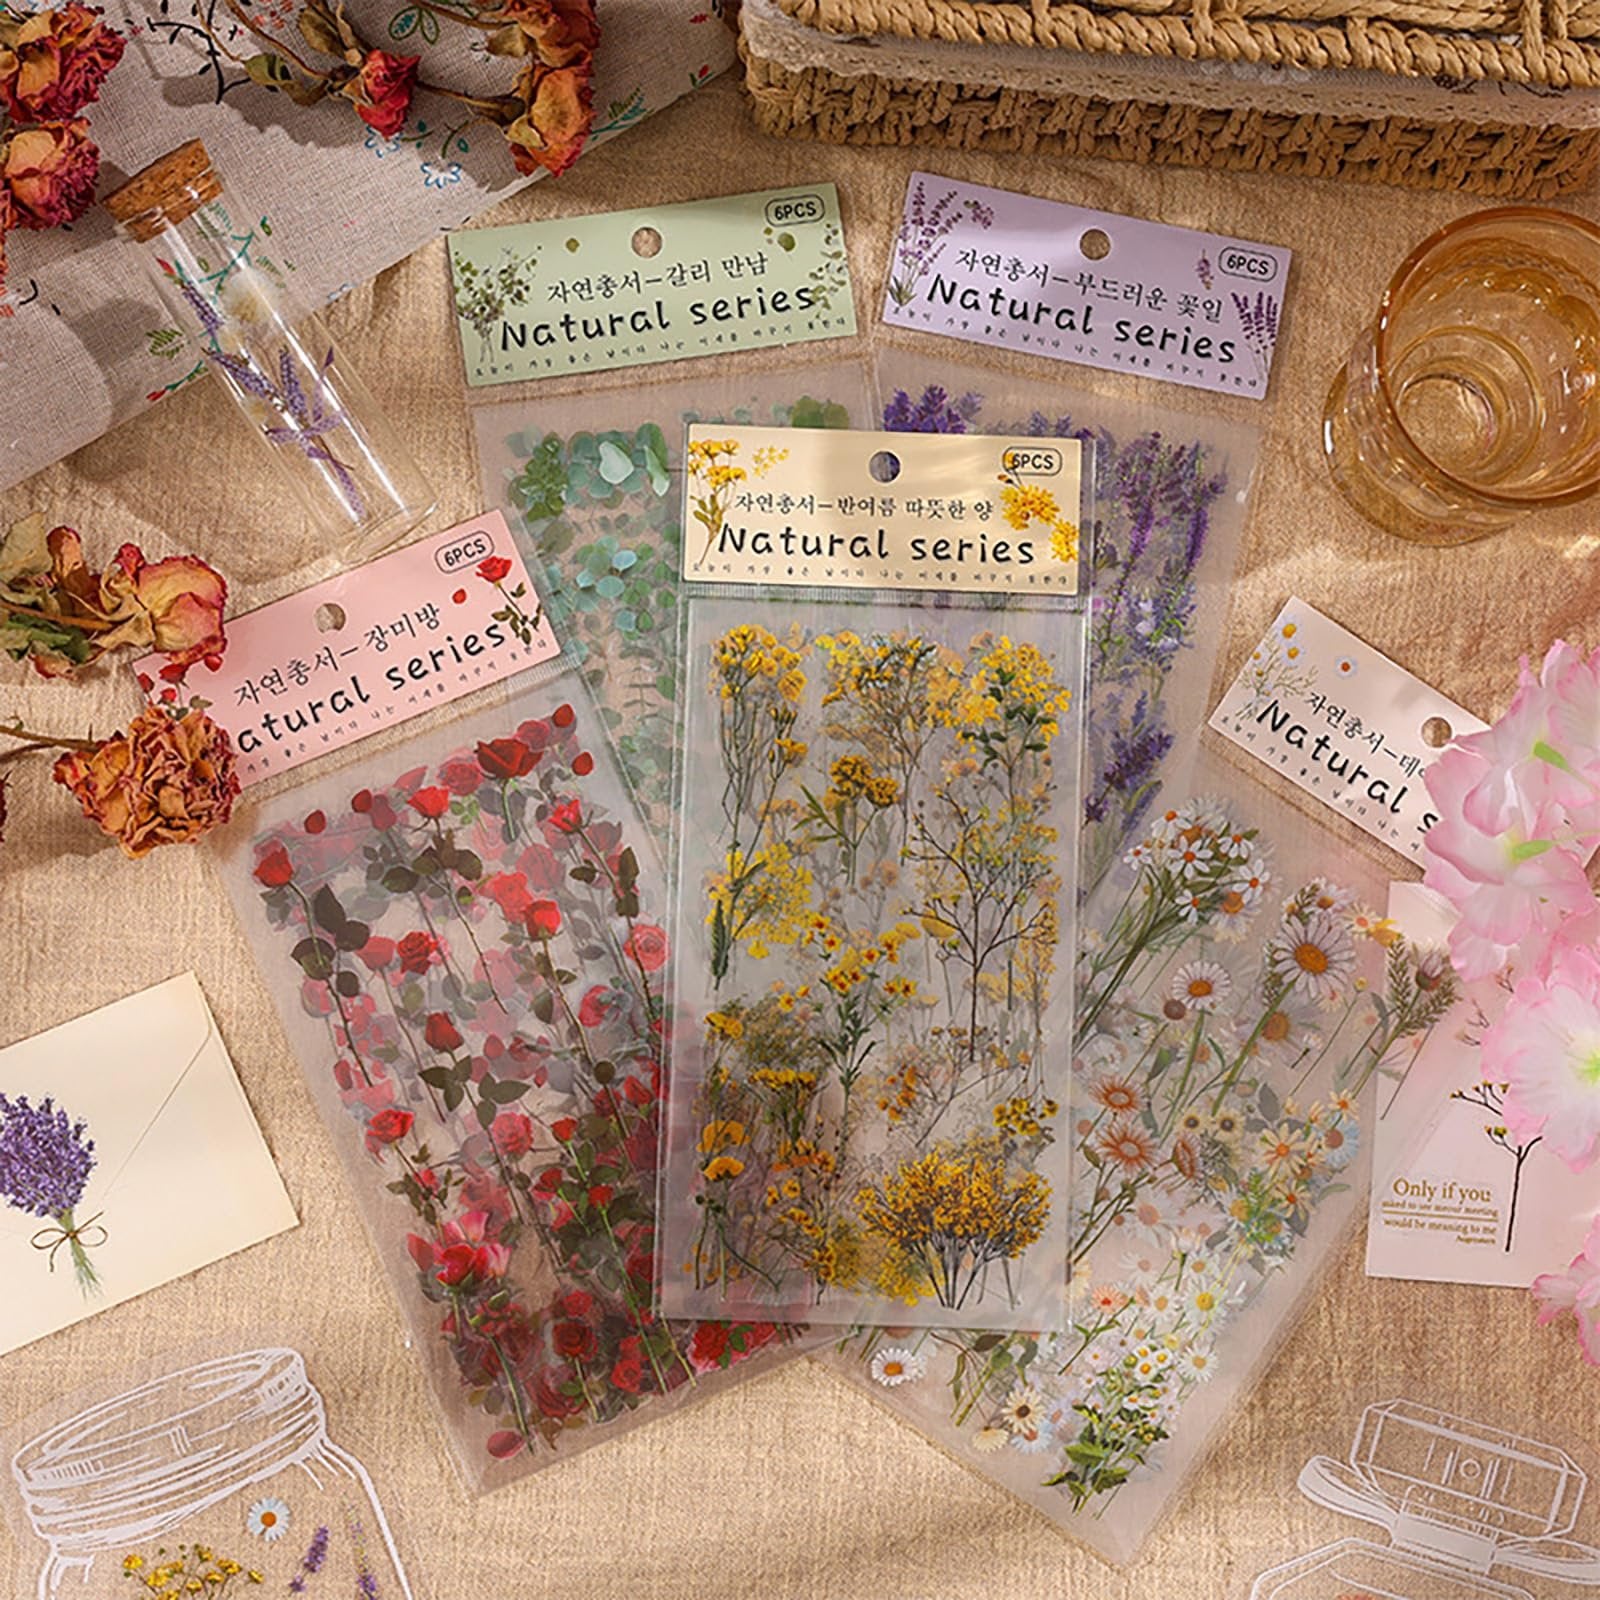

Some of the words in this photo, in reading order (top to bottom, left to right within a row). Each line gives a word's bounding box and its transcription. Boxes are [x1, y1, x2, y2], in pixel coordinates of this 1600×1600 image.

[774, 198, 819, 220] 6PCS
[721, 252, 768, 279] 만남
[1226, 254, 1270, 276] 6PCS
[500, 301, 671, 351] Natural
[690, 287, 815, 326] series
[927, 274, 1093, 335] Natural
[1114, 321, 1235, 363] series
[1011, 453, 1054, 471] 6PCS
[905, 498, 966, 520] 따뜻한
[973, 500, 994, 521] 양
[444, 538, 487, 567] 6PCS
[718, 523, 889, 559] Natural
[911, 534, 1034, 564] series
[237, 679, 370, 753] atural
[385, 619, 505, 691] series
[1256, 698, 1409, 813] Natural
[1393, 1177, 1437, 1202] Only
[1442, 1181, 1457, 1199] if
